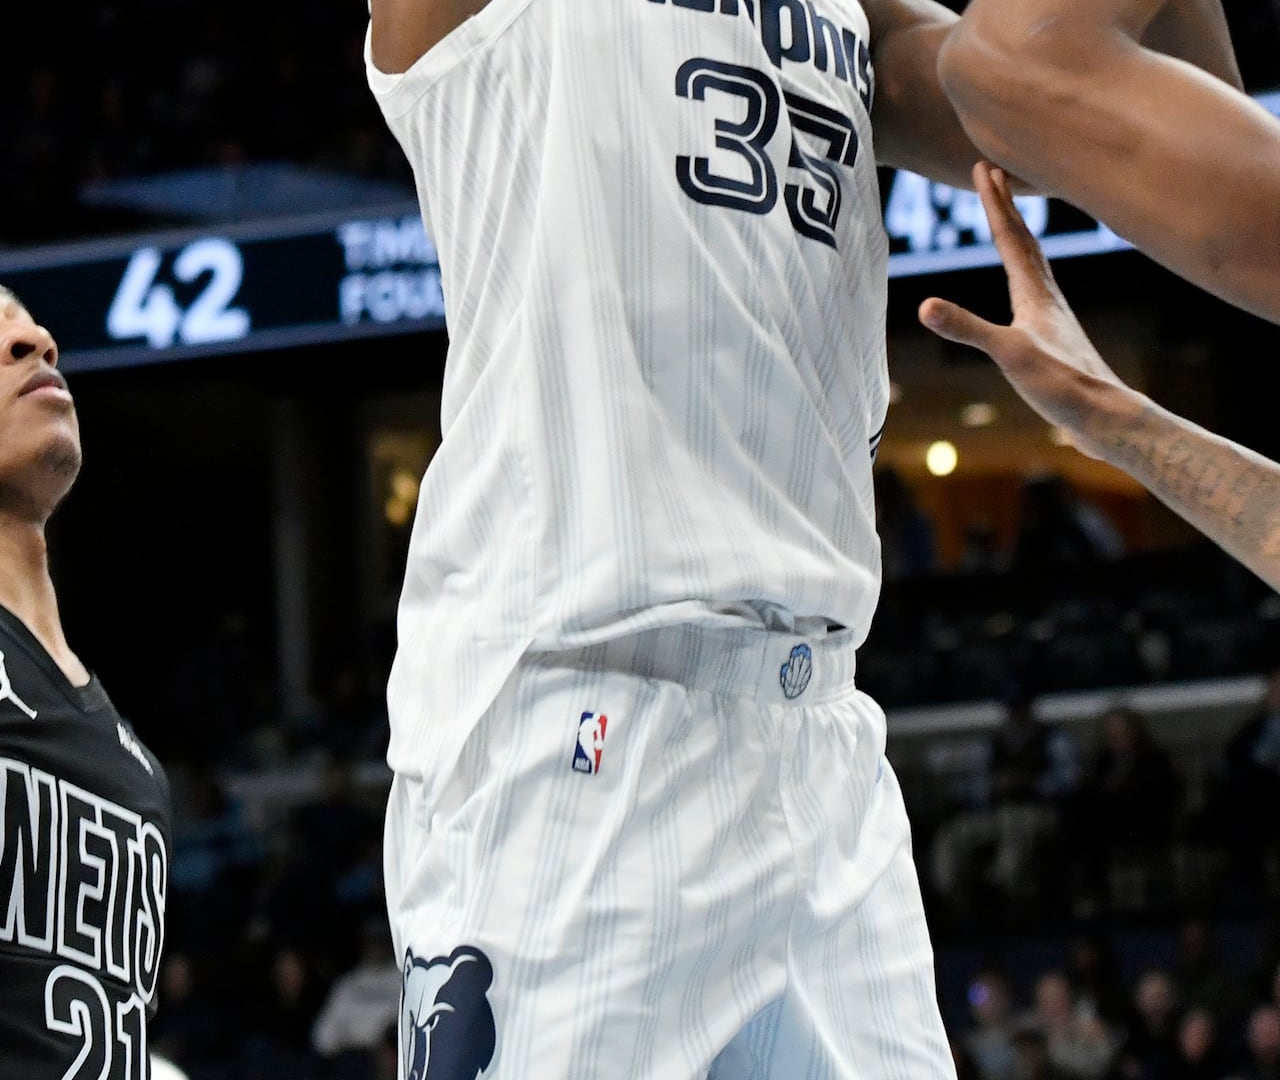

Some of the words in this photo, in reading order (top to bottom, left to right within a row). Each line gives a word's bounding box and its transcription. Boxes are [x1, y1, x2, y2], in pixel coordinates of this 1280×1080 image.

[675, 57, 859, 251] 35
[106, 238, 250, 349] 42
[45, 964, 149, 1080] 21
